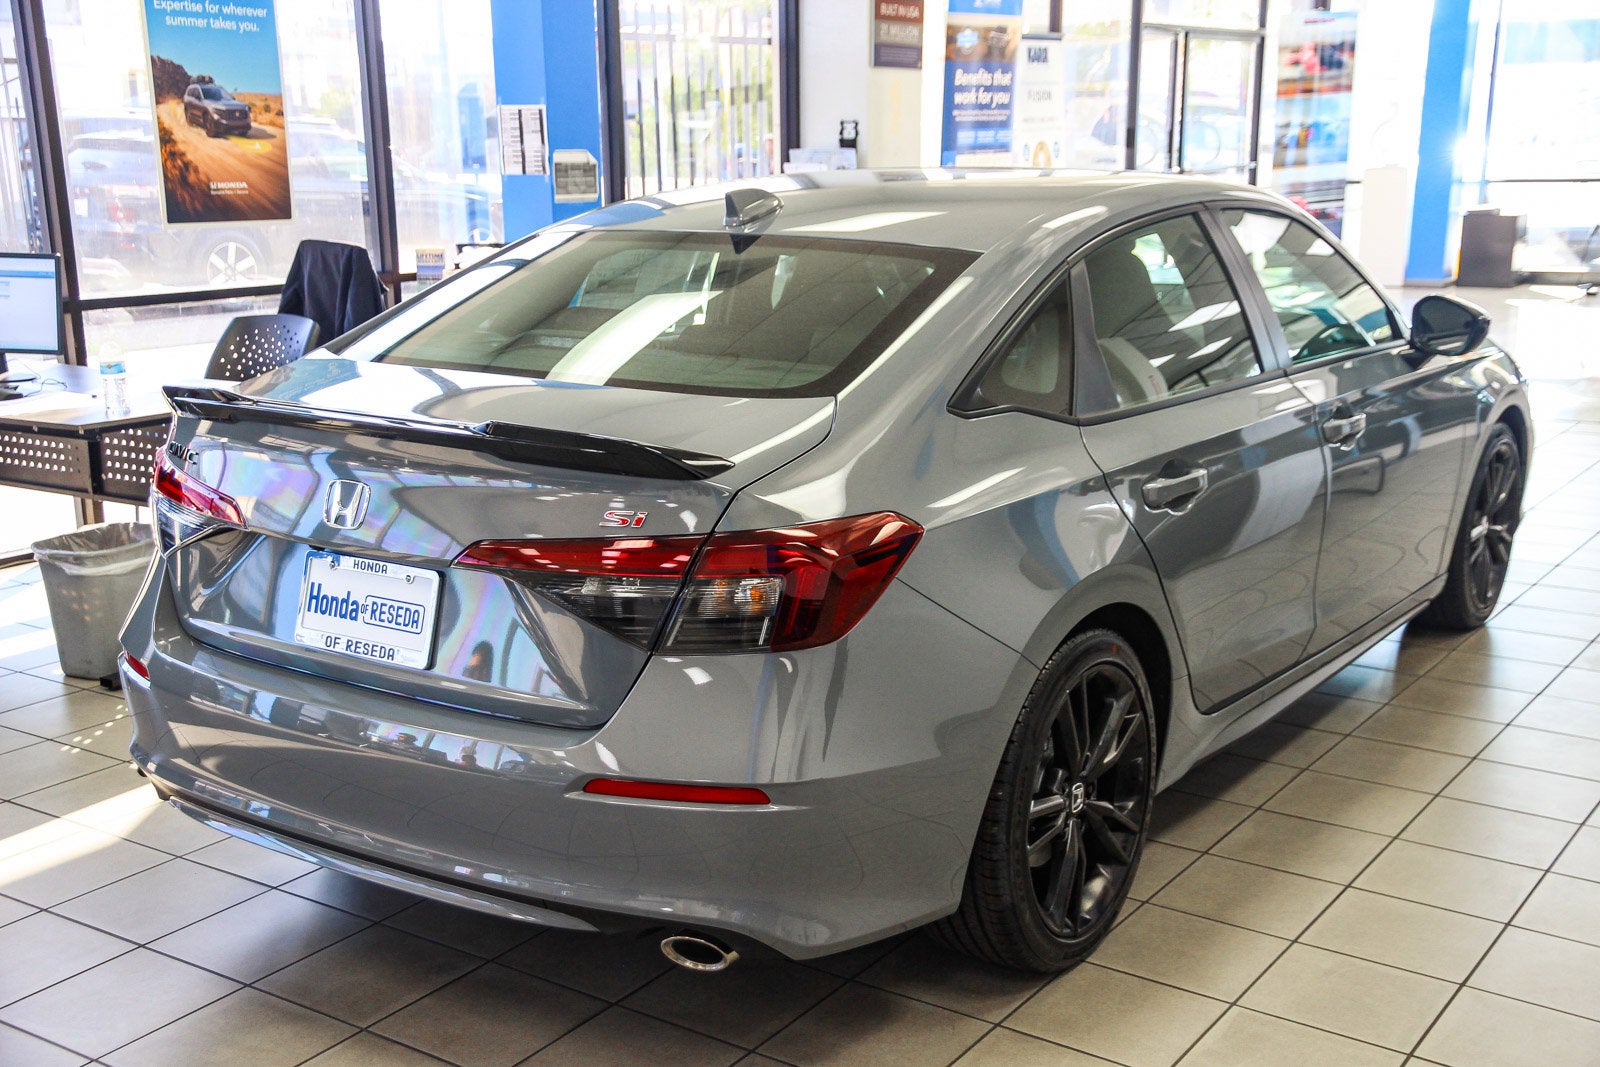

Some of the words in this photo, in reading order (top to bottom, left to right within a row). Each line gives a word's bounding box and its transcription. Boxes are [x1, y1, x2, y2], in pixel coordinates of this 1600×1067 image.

[153, 0, 203, 13] Expertise
[205, 1, 220, 14] for
[222, 3, 268, 18] wherever
[165, 15, 208, 28] summer
[210, 17, 237, 30] takes
[238, 22, 260, 33] you.
[954, 68, 992, 87] Benefits
[993, 69, 1013, 87] that
[953, 88, 977, 105] work
[977, 86, 992, 105] for
[991, 91, 1011, 109] you
[168, 440, 200, 465] CIVIC
[599, 510, 649, 528] Si
[353, 559, 388, 575] HONDA
[306, 581, 360, 622] Honda
[360, 603, 370, 615] OF
[369, 600, 421, 629] RESEDA
[324, 635, 341, 649] OF
[345, 639, 395, 661] RESEDA
